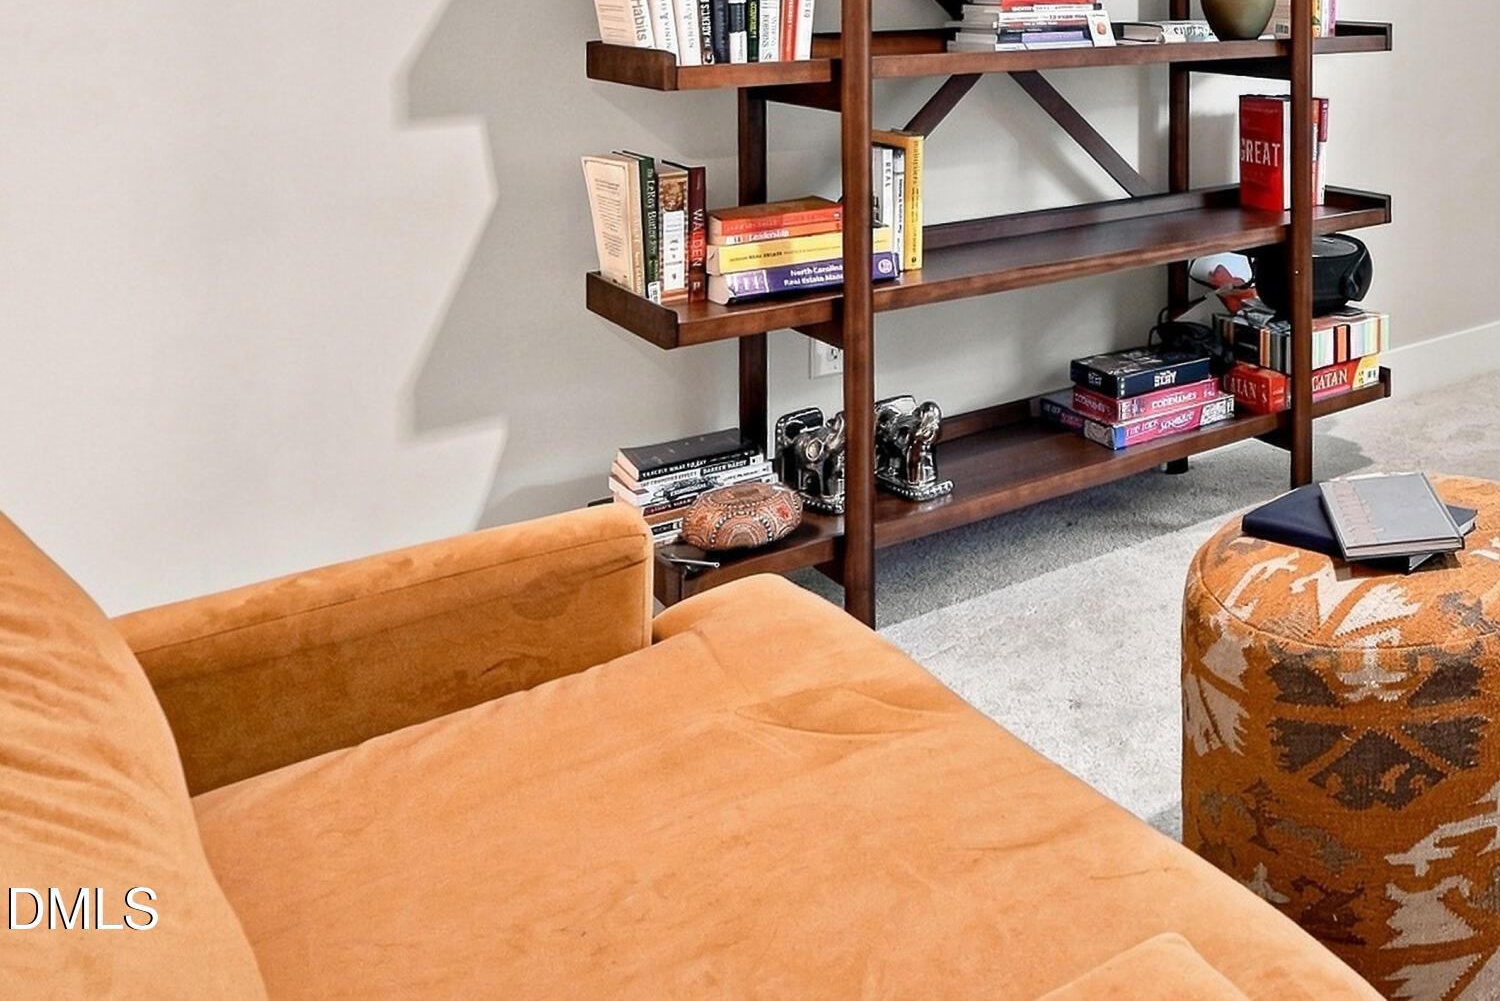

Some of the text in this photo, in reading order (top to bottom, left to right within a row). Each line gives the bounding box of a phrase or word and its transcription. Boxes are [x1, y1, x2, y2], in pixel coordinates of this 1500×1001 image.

[645, 180, 656, 209] LeRoy
[647, 211, 657, 238] Butler
[692, 209, 705, 267] WALDEN
[783, 278, 801, 286] Real
[801, 276, 825, 285] Estate
[790, 267, 813, 277] North
[1312, 369, 1348, 392] CATAN
[703, 465, 727, 474] DARREN
